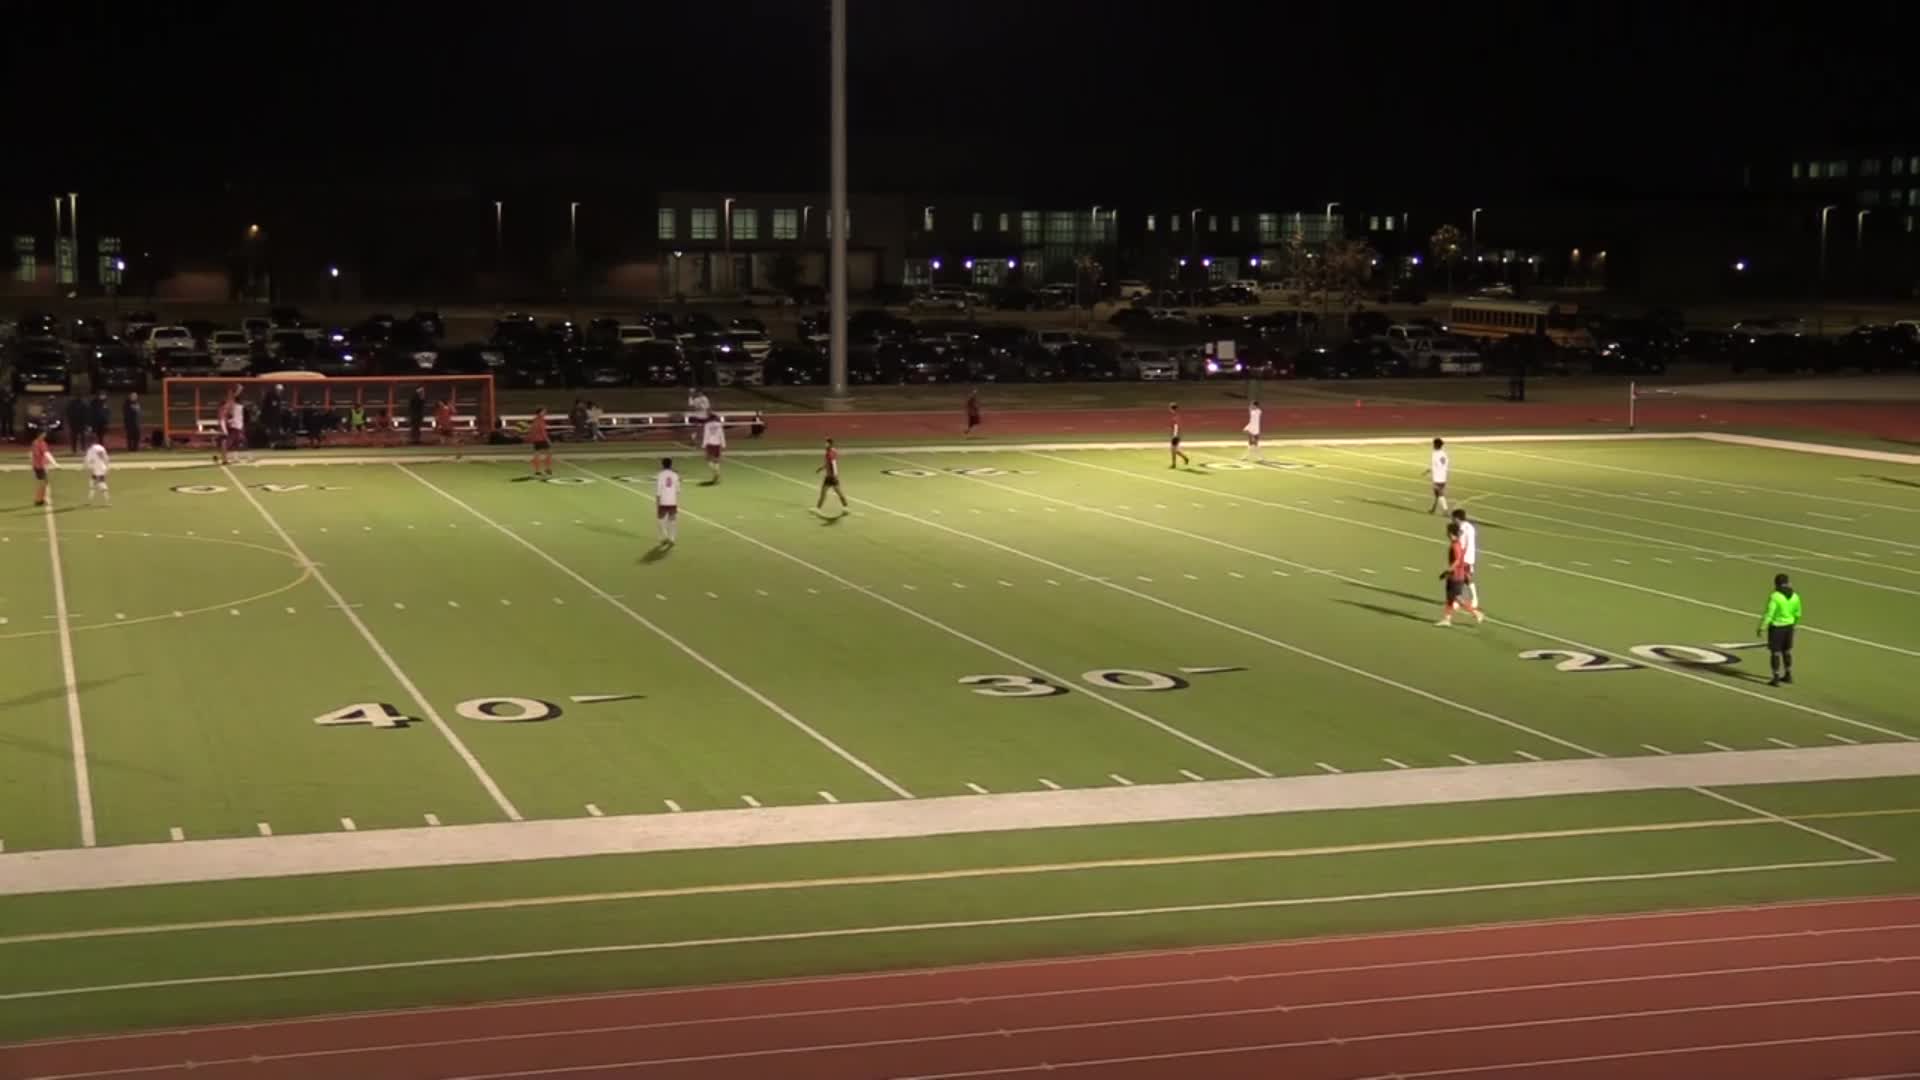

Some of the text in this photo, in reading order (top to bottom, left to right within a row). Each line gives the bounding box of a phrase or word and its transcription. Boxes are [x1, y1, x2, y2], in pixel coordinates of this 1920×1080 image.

[1518, 644, 1742, 671] 20
[957, 669, 1190, 696] 30
[313, 697, 563, 728] 40
